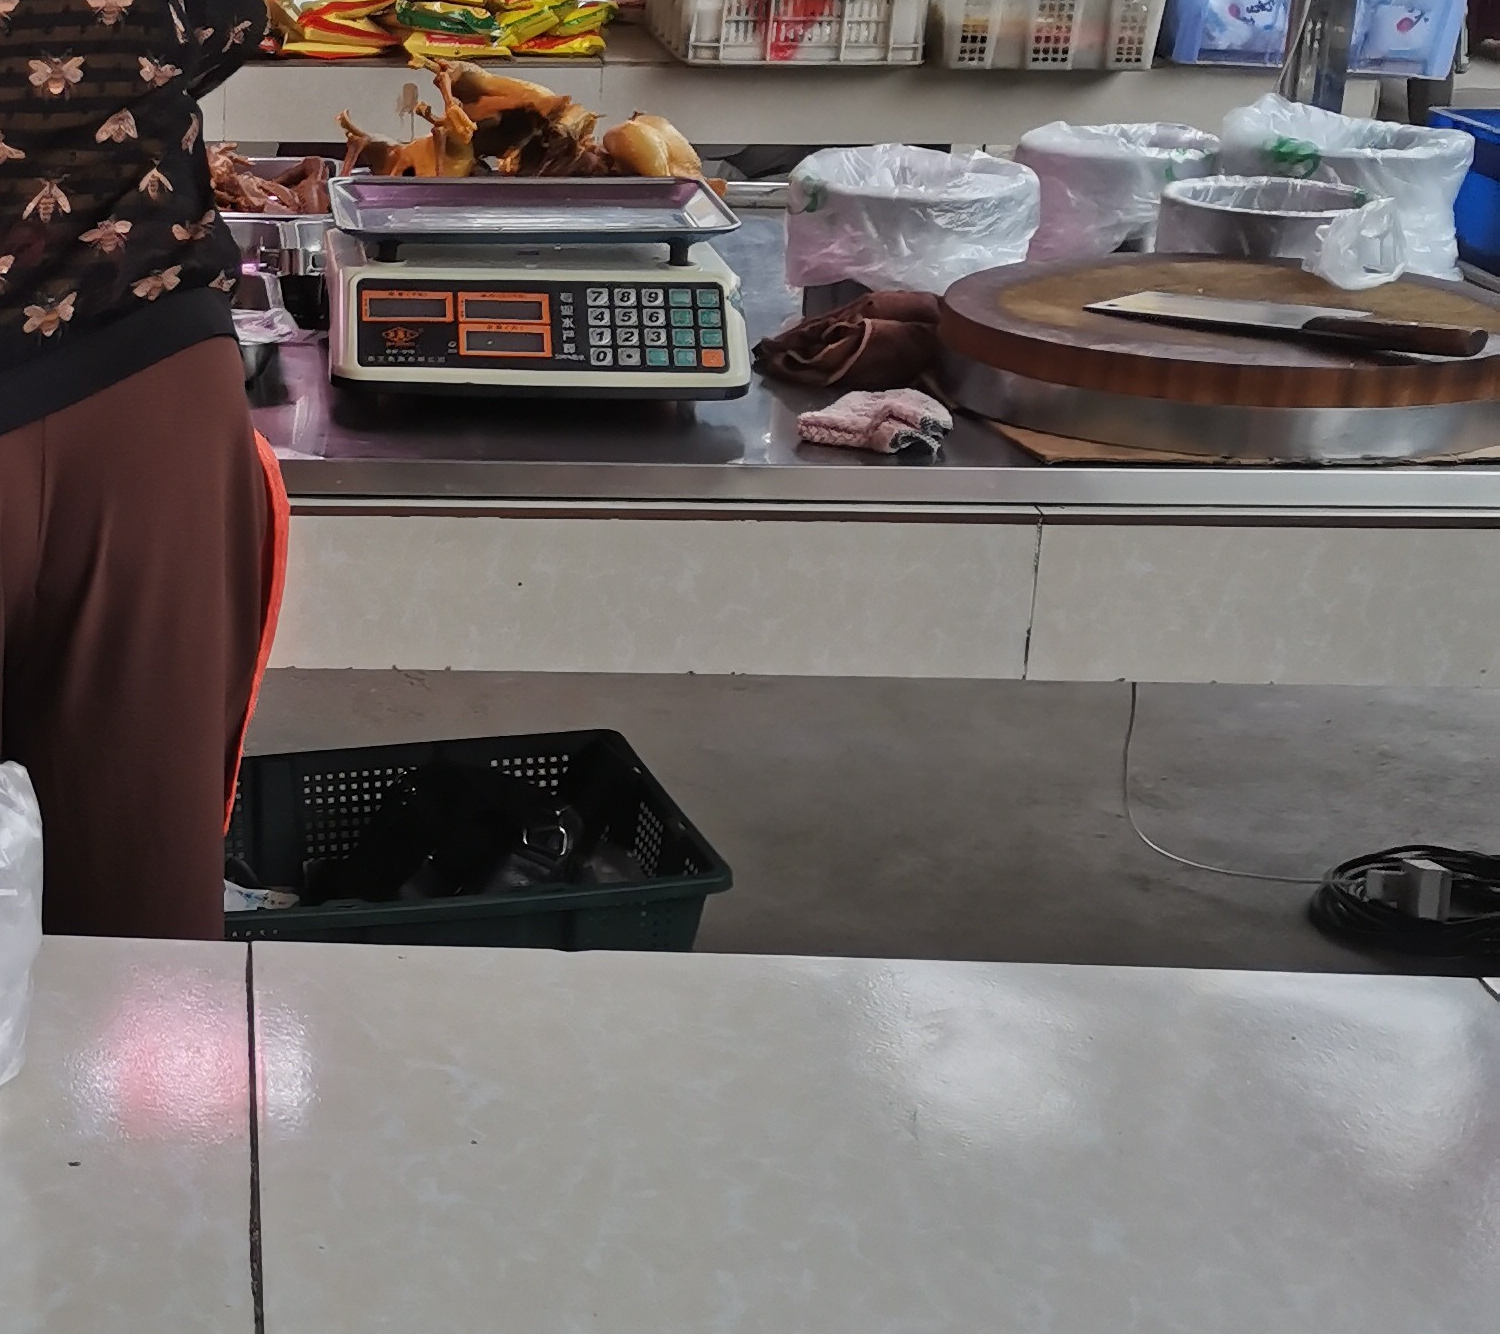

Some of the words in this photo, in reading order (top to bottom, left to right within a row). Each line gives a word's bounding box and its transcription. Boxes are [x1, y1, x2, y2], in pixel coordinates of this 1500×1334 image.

[591, 290, 604, 303] 7
[619, 291, 632, 303] 8
[646, 291, 659, 303] 9
[593, 310, 606, 323] 4
[620, 310, 633, 323] 5
[648, 311, 661, 323] 6
[621, 330, 635, 343] 2
[649, 331, 661, 343] 3
[595, 350, 608, 363] 0
